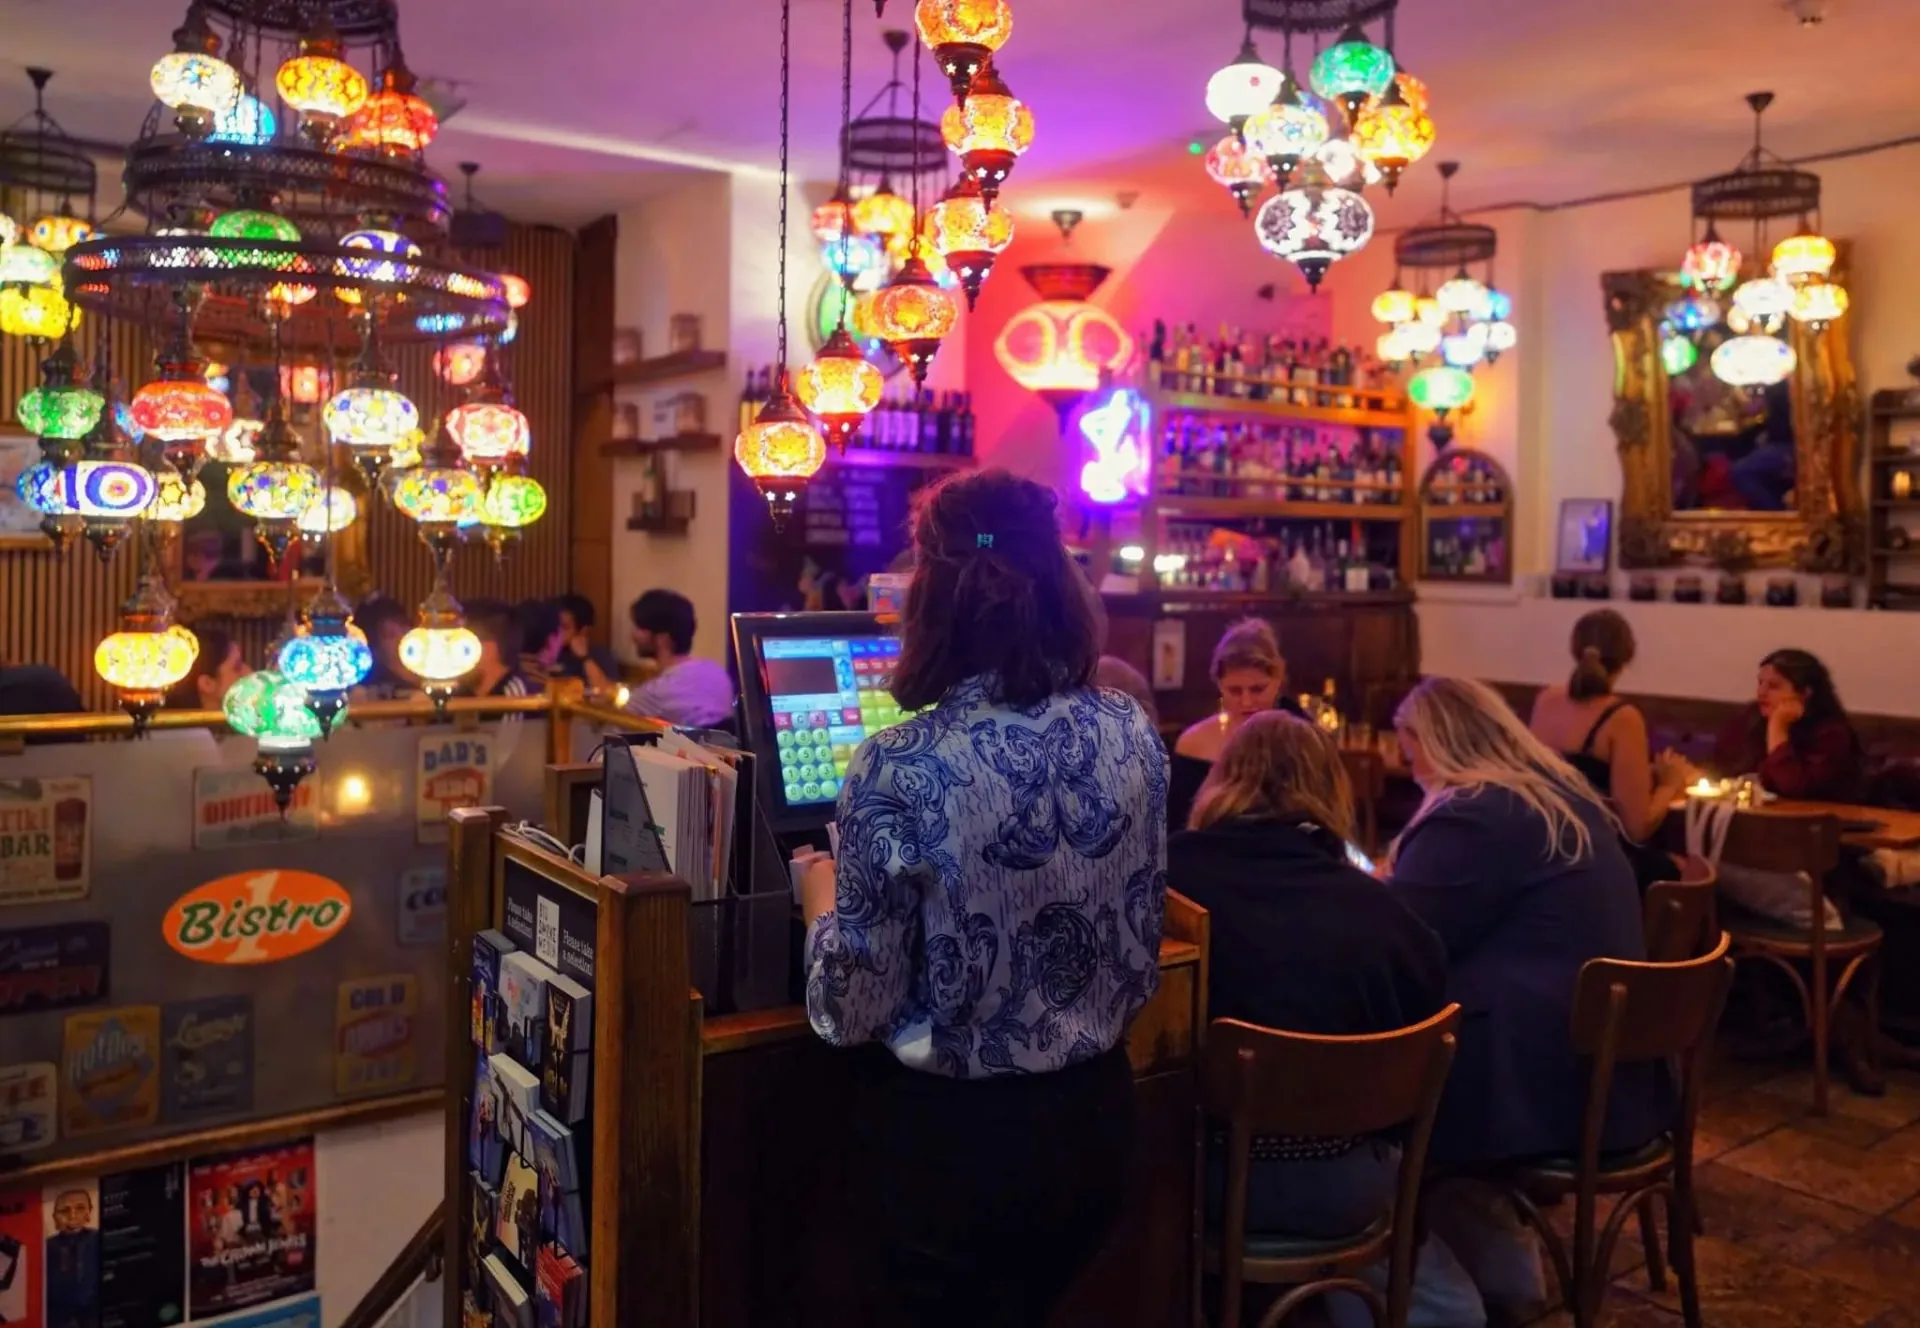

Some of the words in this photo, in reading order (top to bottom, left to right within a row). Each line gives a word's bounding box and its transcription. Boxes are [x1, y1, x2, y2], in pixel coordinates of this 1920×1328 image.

[0, 832, 51, 858] BAR
[178, 897, 347, 947] Bistro
[563, 928, 581, 953] Please
[580, 939, 594, 960] take
